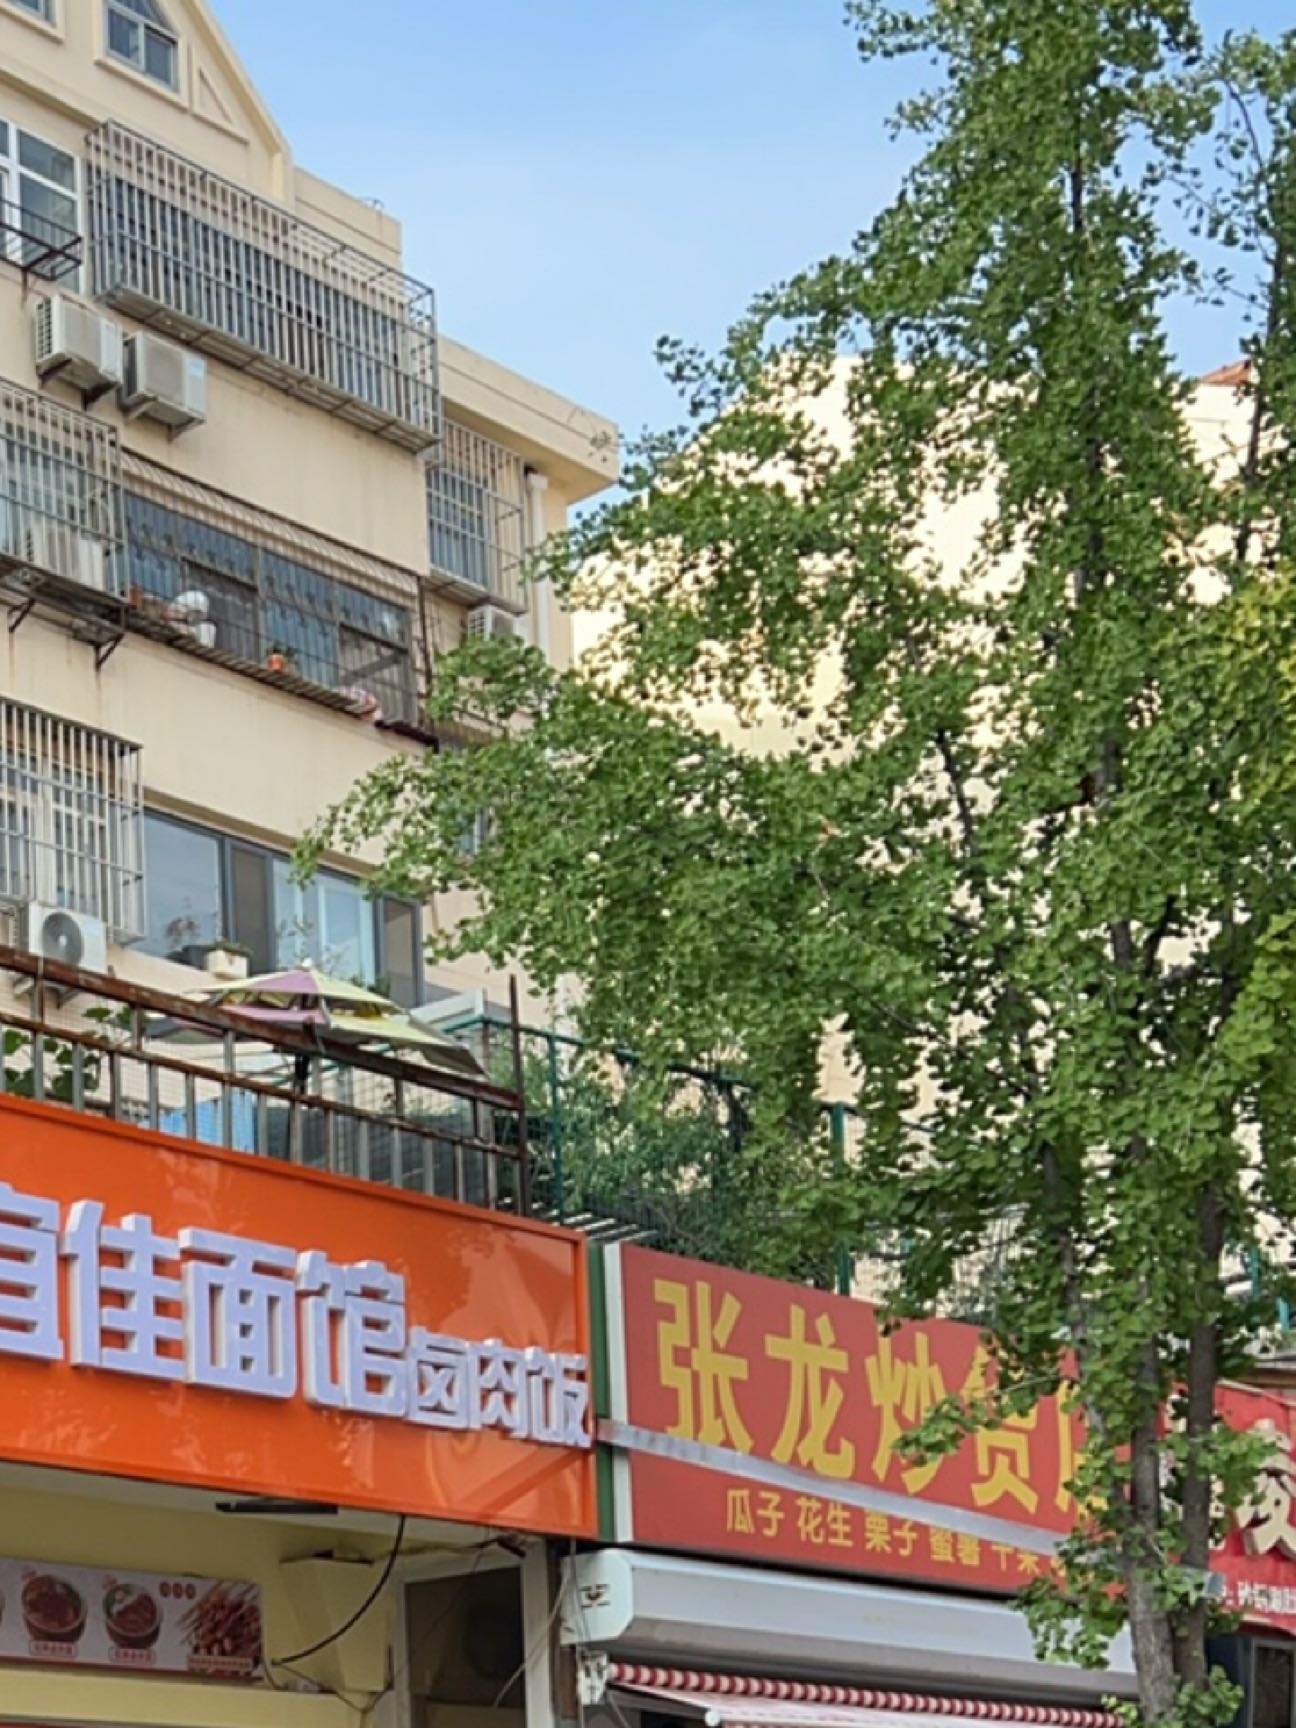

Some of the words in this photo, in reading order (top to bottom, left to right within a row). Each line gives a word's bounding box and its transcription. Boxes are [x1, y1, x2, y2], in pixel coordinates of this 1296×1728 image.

[406, 1326, 592, 1449] 卤肉饭
[653, 1278, 1109, 1518] 张龙炒货
[726, 1488, 784, 1538] 瓜子
[796, 1497, 853, 1547] 花生
